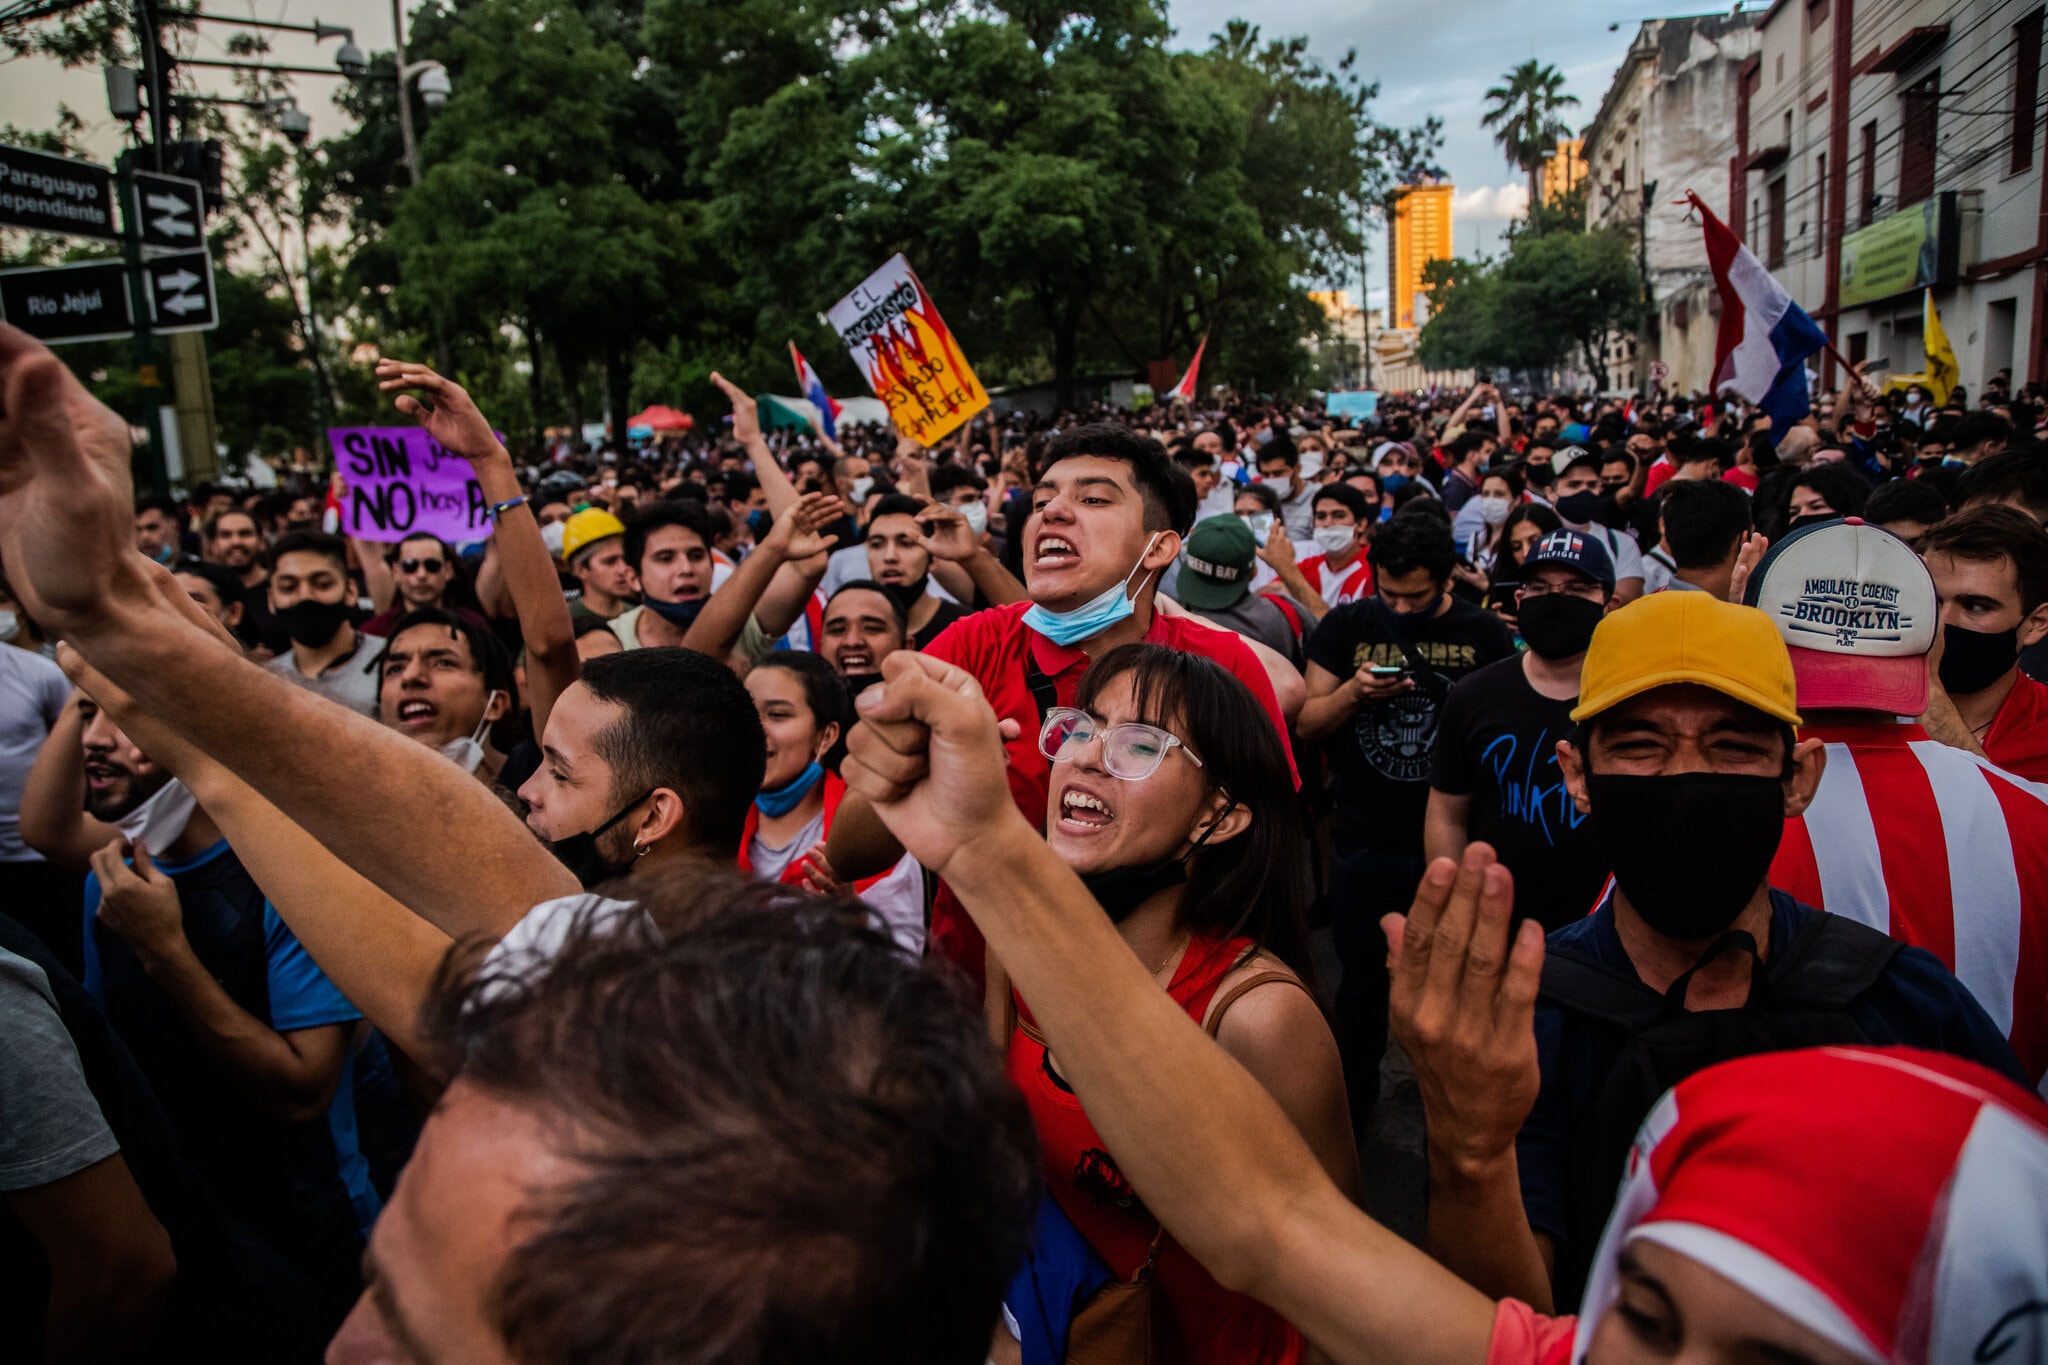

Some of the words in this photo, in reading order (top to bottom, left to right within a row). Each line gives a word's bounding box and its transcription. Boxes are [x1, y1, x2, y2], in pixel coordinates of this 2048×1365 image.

[0, 162, 98, 201] Paraguayo
[0, 192, 105, 224] ependiente
[843, 281, 919, 348] MACHISMO
[851, 286, 880, 311] EL
[343, 433, 412, 477] SIN
[353, 481, 416, 531] NO
[1537, 550, 1580, 561] HILFIGER
[1216, 565, 1239, 580] BAY
[1803, 579, 1859, 596] AMBULATE
[1861, 583, 1900, 603] COEXIST
[1794, 601, 1900, 630] BROOKLYN
[1481, 727, 1554, 847] PINK
